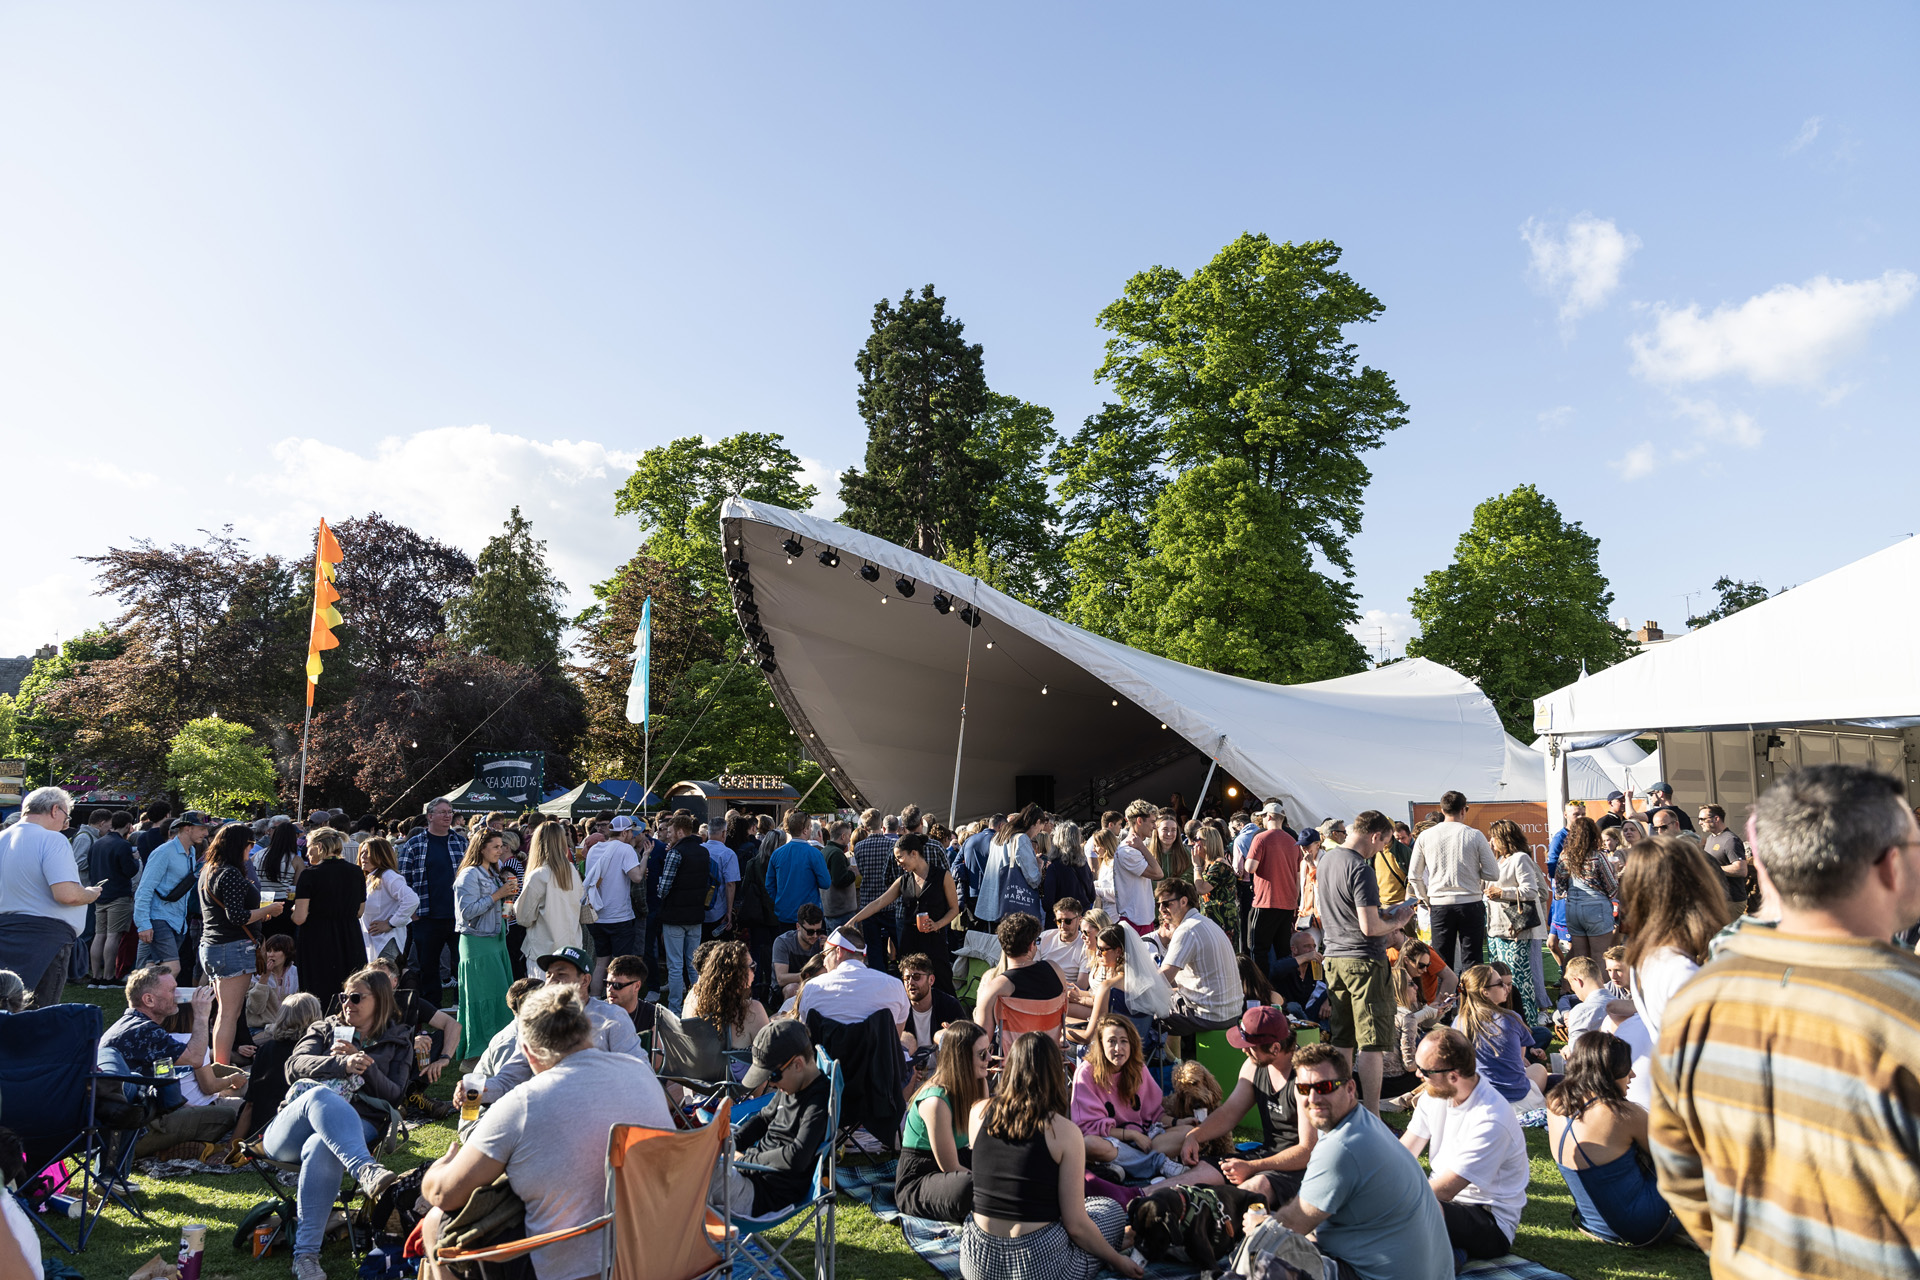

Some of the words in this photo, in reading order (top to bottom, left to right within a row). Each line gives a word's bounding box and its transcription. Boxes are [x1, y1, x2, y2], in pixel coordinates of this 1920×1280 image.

[485, 776, 499, 788] SEA
[500, 775, 527, 788] SALTED
[719, 774, 784, 789] COFFEE
[1006, 884, 1032, 896] CHELSEA
[1004, 893, 1035, 904] MARKET
